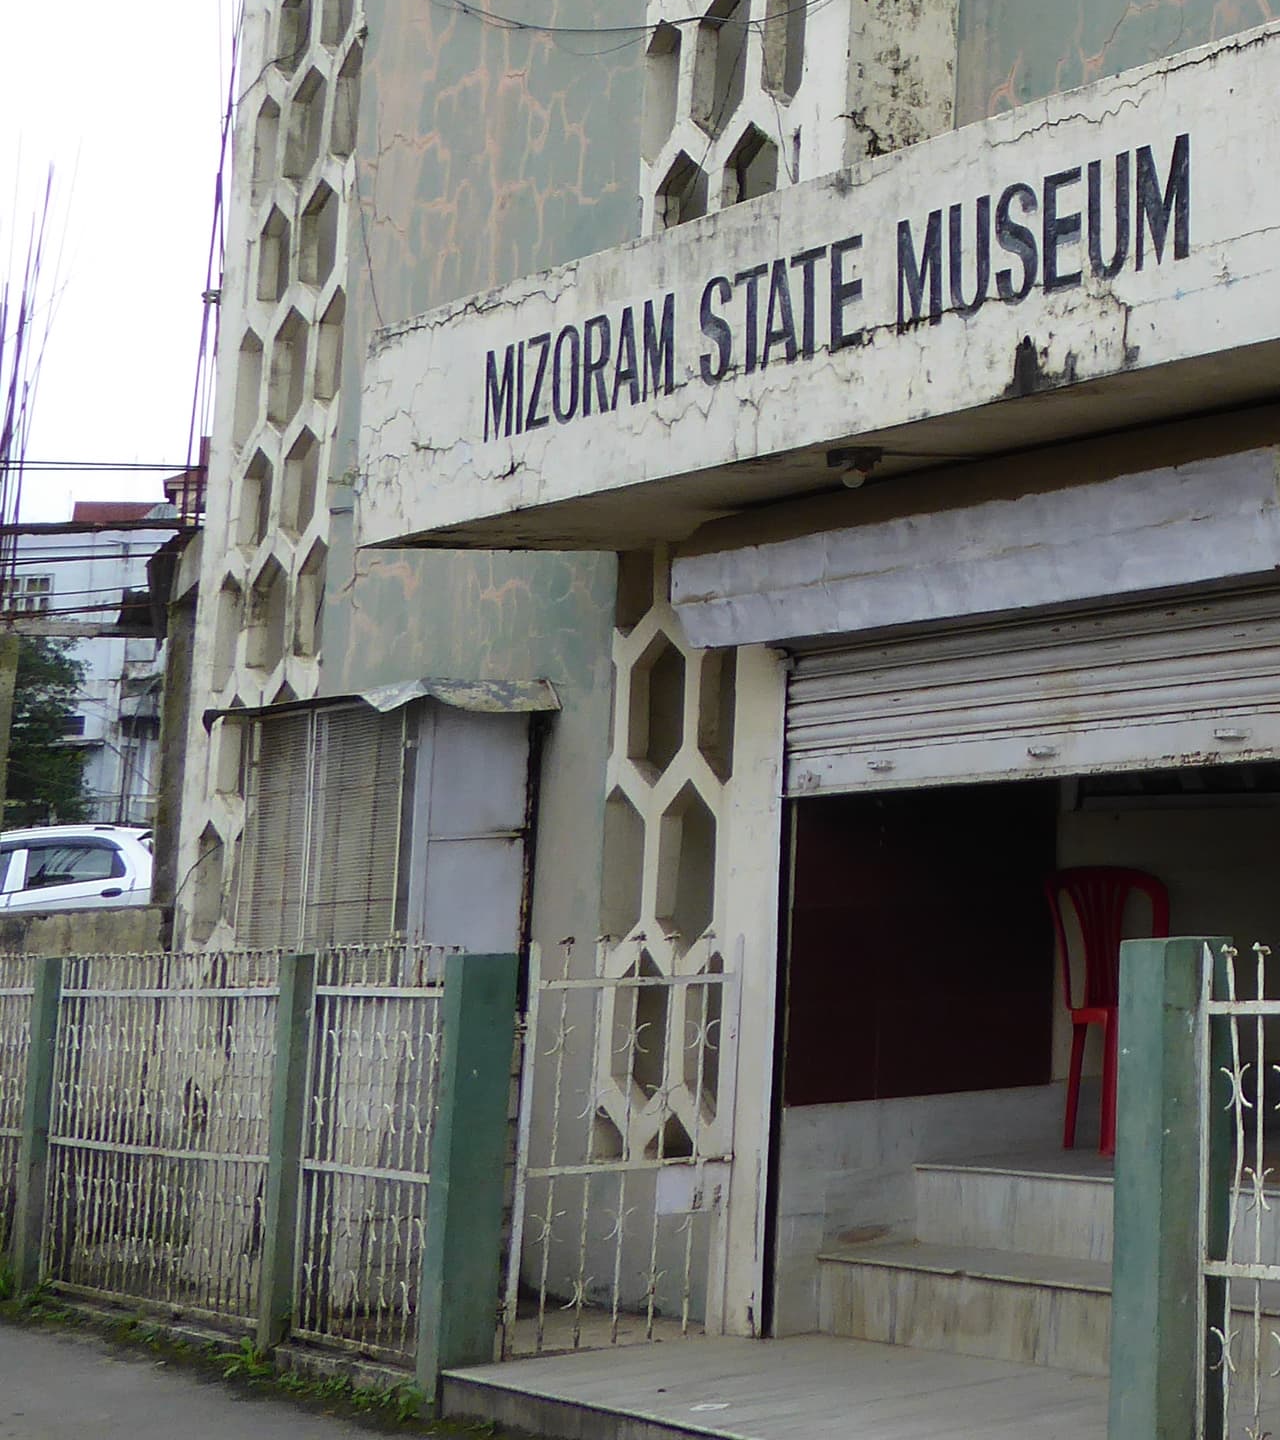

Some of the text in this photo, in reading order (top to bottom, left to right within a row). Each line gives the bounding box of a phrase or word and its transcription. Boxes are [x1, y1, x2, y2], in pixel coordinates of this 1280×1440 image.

[483, 133, 1191, 444] MIZORAM STATE MUSEUM
